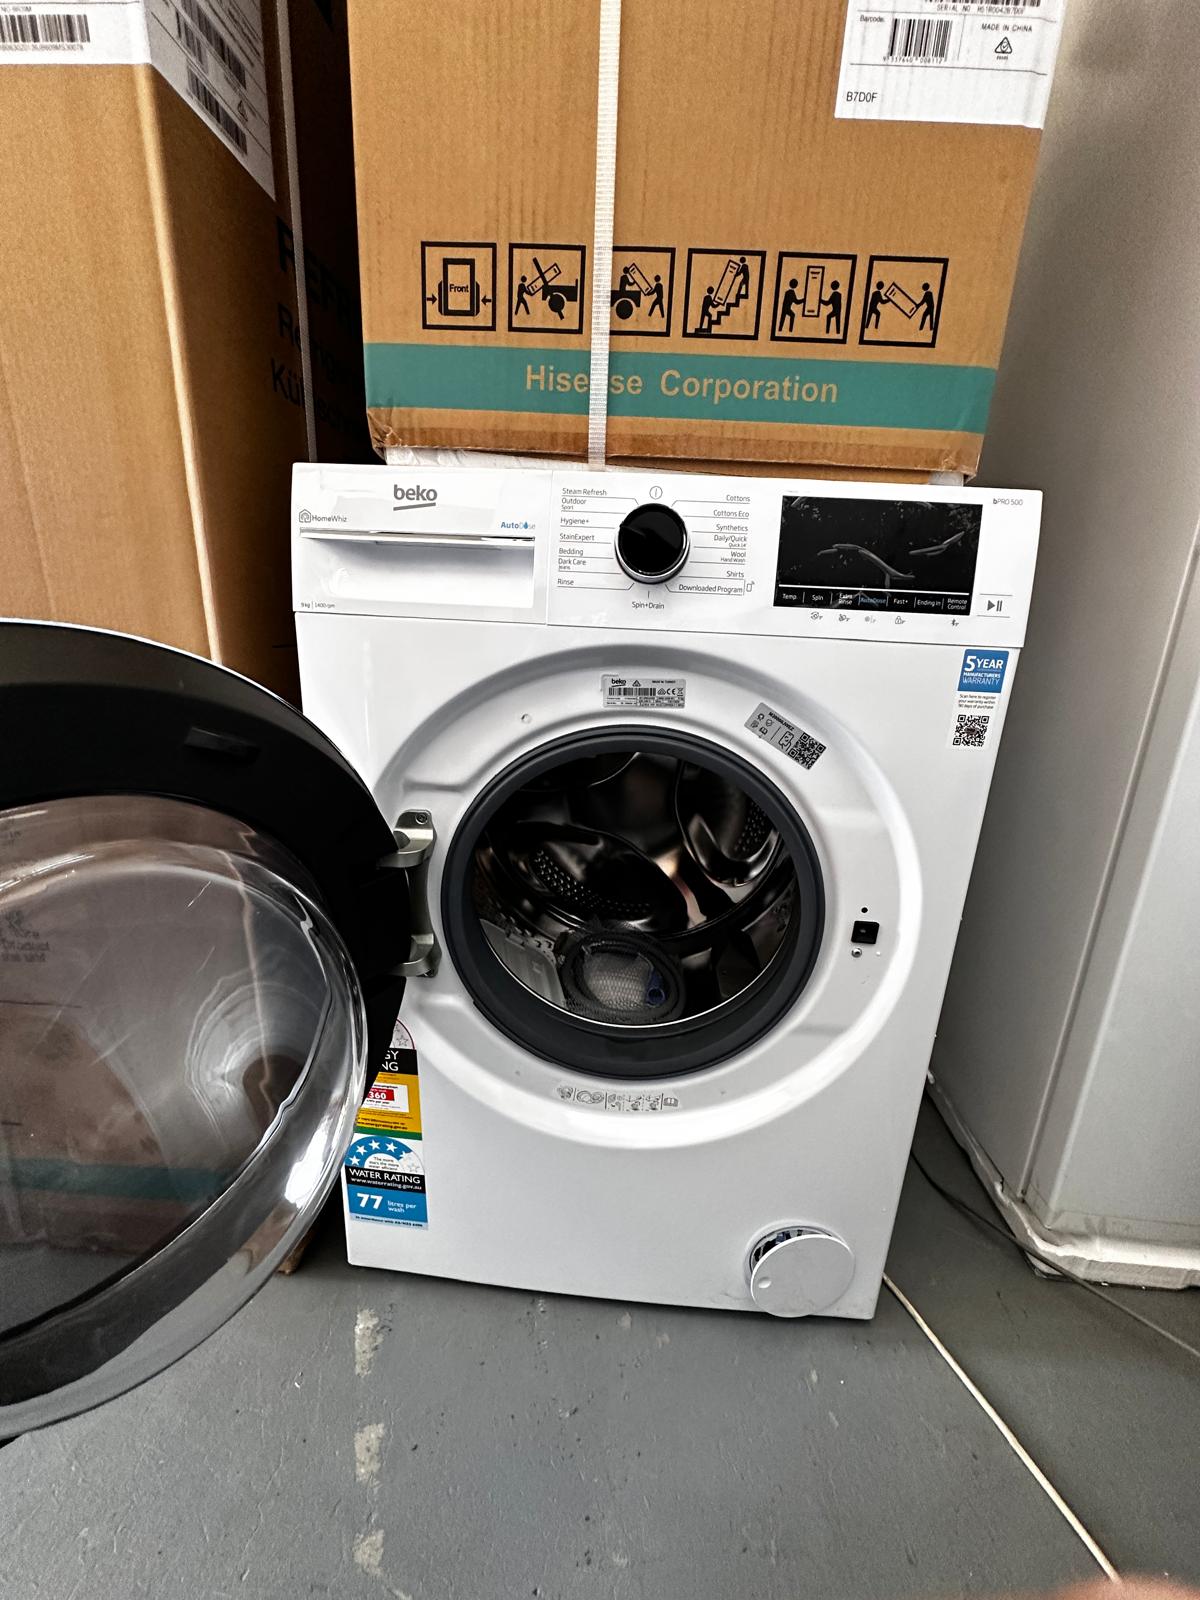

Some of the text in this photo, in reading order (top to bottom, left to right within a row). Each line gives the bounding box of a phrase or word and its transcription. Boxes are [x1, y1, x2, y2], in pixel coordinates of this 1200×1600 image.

[981, 23, 999, 31] MADE
[846, 91, 878, 103] B7D0F
[449, 283, 470, 294] Front
[525, 364, 838, 404] Hisese Corporation
[393, 483, 438, 501] beko
[561, 497, 587, 505] Outdoor
[726, 494, 751, 502] Cottons
[713, 509, 737, 517] Cottons
[312, 514, 348, 523] HomeWhiz
[560, 517, 589, 526] Hygiene+
[716, 524, 749, 532] Synthetics
[559, 533, 595, 542] StainExpert
[713, 534, 747, 543] Daily/Quick
[558, 548, 584, 557] Bedding
[730, 550, 746, 558] Wool
[726, 570, 745, 578] Shirts
[557, 578, 575, 586] Rinse
[678, 583, 743, 594] Downloaded Program
[811, 593, 824, 602] Spin
[893, 597, 909, 605] Fast+
[631, 601, 665, 609] Spin+Drain
[917, 599, 934, 607] Ending
[963, 655, 1004, 672] 5 YEAR
[962, 676, 1000, 686] WARRANTY
[368, 1091, 387, 1100] 360
[349, 1168, 421, 1184] WATER RATING
[351, 1177, 422, 1190] www.waterrating.gov.au
[356, 1192, 383, 1210] 77
[387, 1200, 404, 1208] litres
